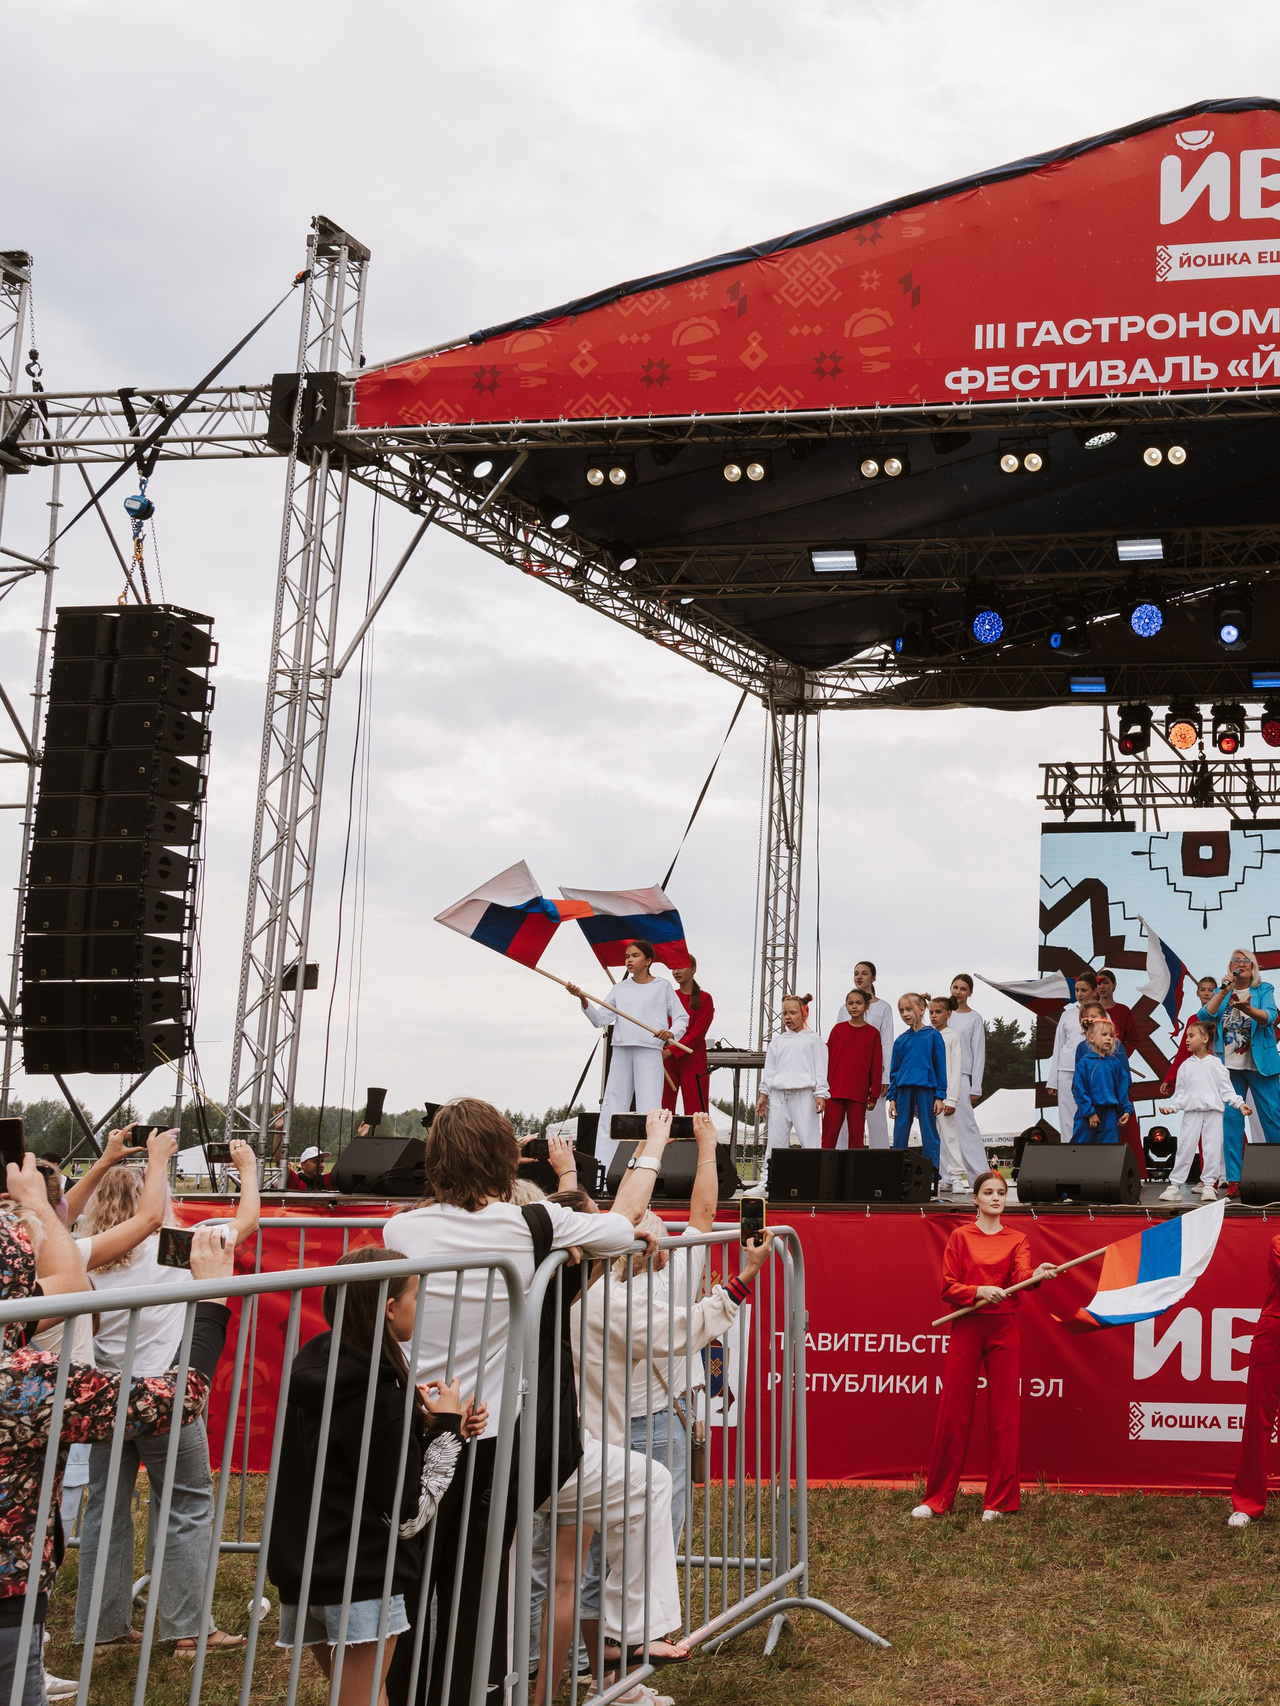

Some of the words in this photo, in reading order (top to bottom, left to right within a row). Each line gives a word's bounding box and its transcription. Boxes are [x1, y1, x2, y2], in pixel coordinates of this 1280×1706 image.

[1178, 252, 1252, 269] ЙОШКА
[974, 323, 1006, 350] III
[944, 355, 1219, 395] ФЕСТИВАЛЬ
[1029, 1377, 1064, 1398] ЭЛ
[1151, 1411, 1222, 1430] ЙОШКА
